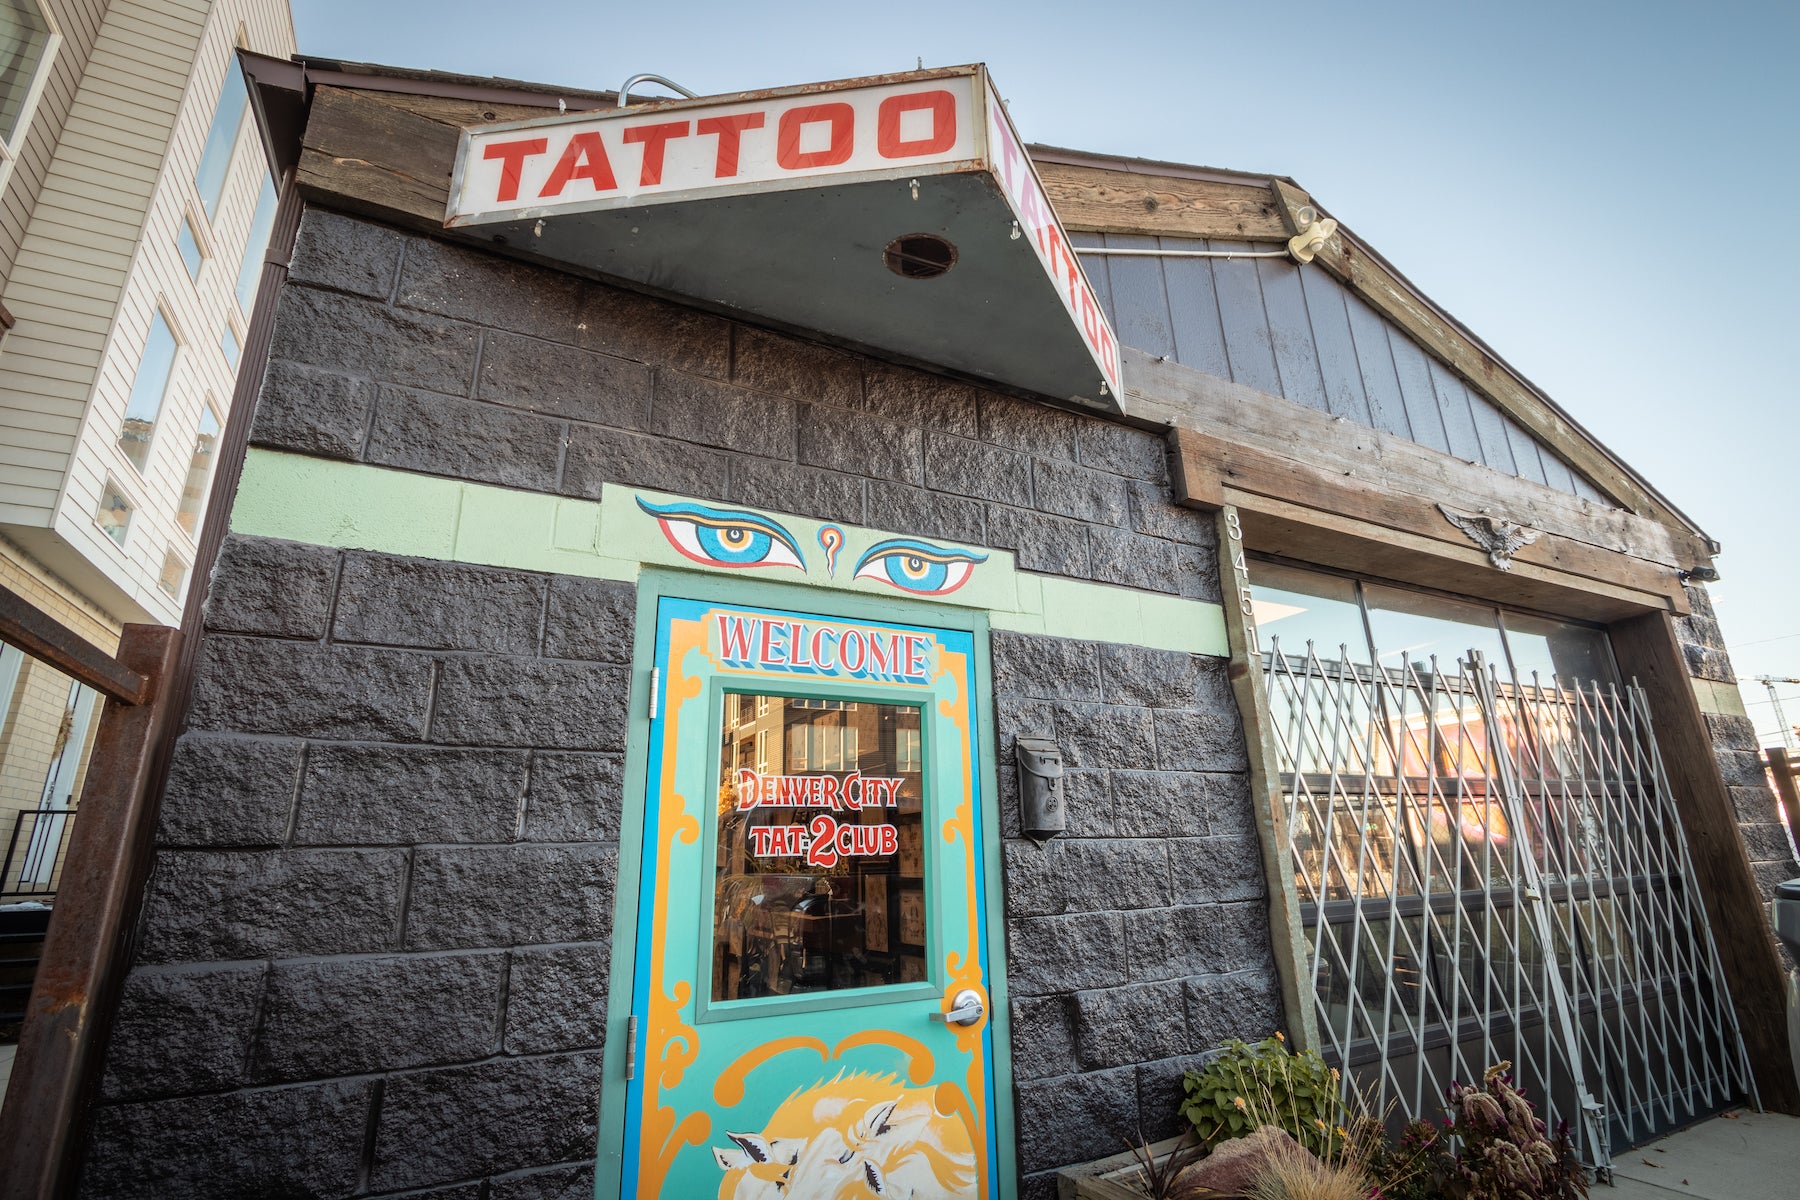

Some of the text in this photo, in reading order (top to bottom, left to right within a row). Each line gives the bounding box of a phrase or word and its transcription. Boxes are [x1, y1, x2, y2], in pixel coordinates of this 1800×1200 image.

[483, 89, 957, 203] TATTOO
[993, 104, 1117, 388] TATTOO
[1227, 513, 1262, 656] 3451
[715, 613, 927, 681] WELCOME
[736, 768, 905, 812] DENVER CITY
[834, 823, 898, 856] CLUB
